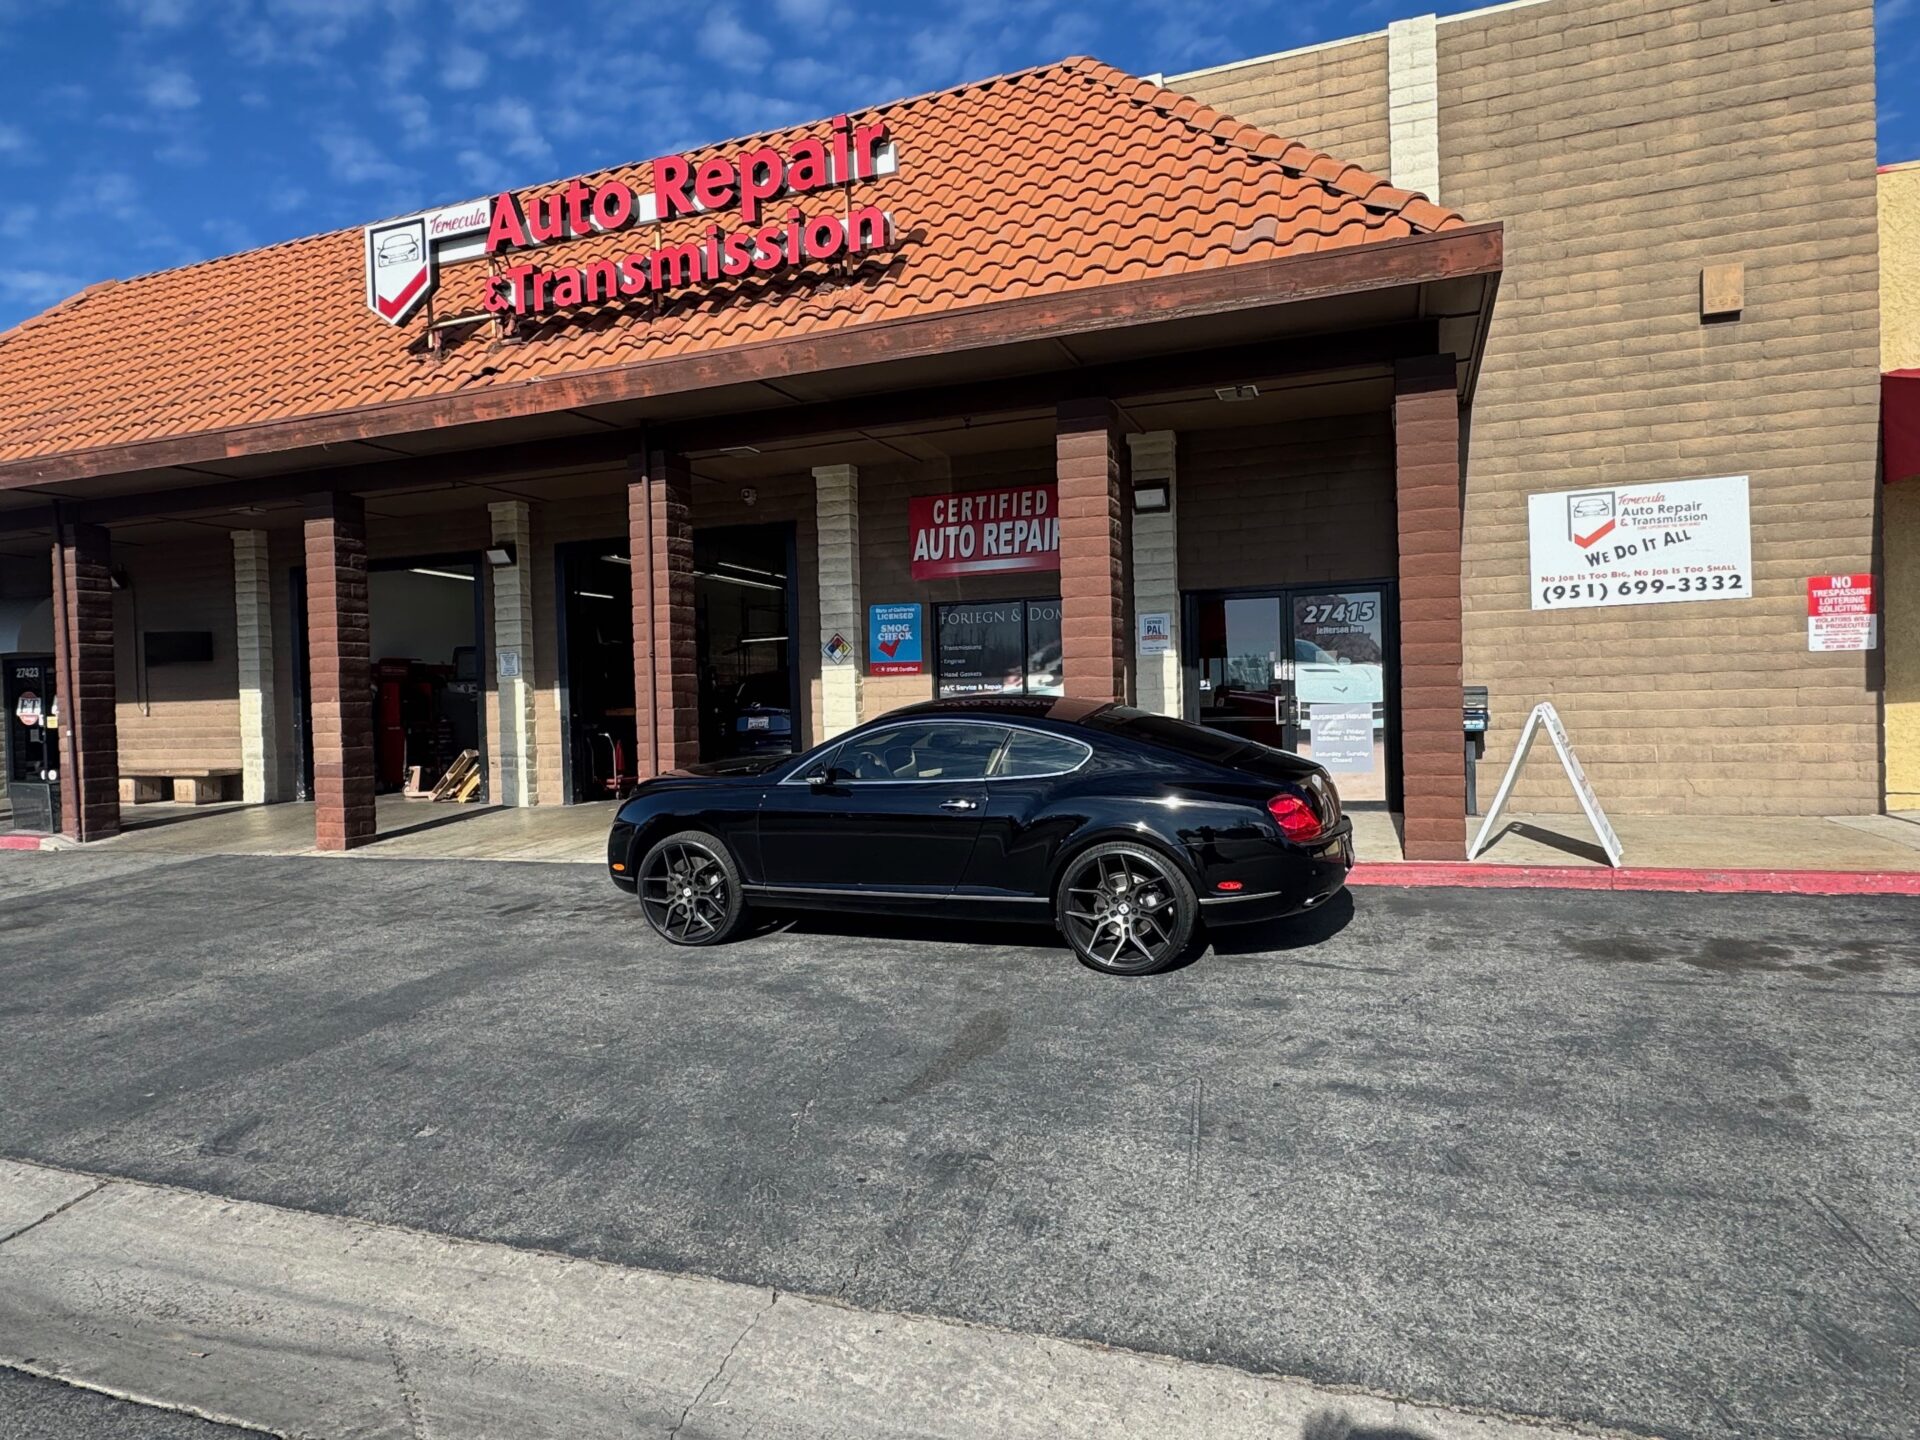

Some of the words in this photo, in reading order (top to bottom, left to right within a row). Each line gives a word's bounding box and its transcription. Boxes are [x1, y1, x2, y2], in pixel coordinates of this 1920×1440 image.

[485, 180, 636, 252] Auto
[653, 114, 889, 224] Repair
[430, 208, 486, 235] Temecula
[508, 207, 887, 315] Transmission
[1617, 492, 1665, 505] Temecula
[933, 489, 1048, 524] CERTIFIED
[1621, 507, 1653, 517] Auto
[1657, 501, 1703, 515] Repair
[1620, 518, 1628, 526] &
[1632, 513, 1708, 526] Transmission
[912, 524, 976, 562] AUTO
[1585, 551, 1611, 567] WE
[1614, 544, 1637, 560] DO
[1642, 538, 1656, 552] IT
[1664, 529, 1692, 546] ALL
[1831, 576, 1852, 588] NO
[1543, 583, 1608, 604] (951)
[1617, 574, 1743, 596] 699-3332
[1812, 587, 1872, 598] TRESPASSING
[1819, 596, 1865, 605] LOITERING
[1303, 601, 1376, 624] 27415
[1817, 604, 1867, 613] SOLICITING
[877, 612, 914, 620] LICENSED
[940, 610, 1005, 625] FORIEGN
[1010, 608, 1021, 622] &
[880, 624, 910, 633] SMOG
[1146, 625, 1162, 635] PAL
[1316, 626, 1349, 635] Jefferson
[1350, 625, 1363, 633] Ave
[877, 631, 913, 641] CHECK
[16, 667, 39, 678] 27423
